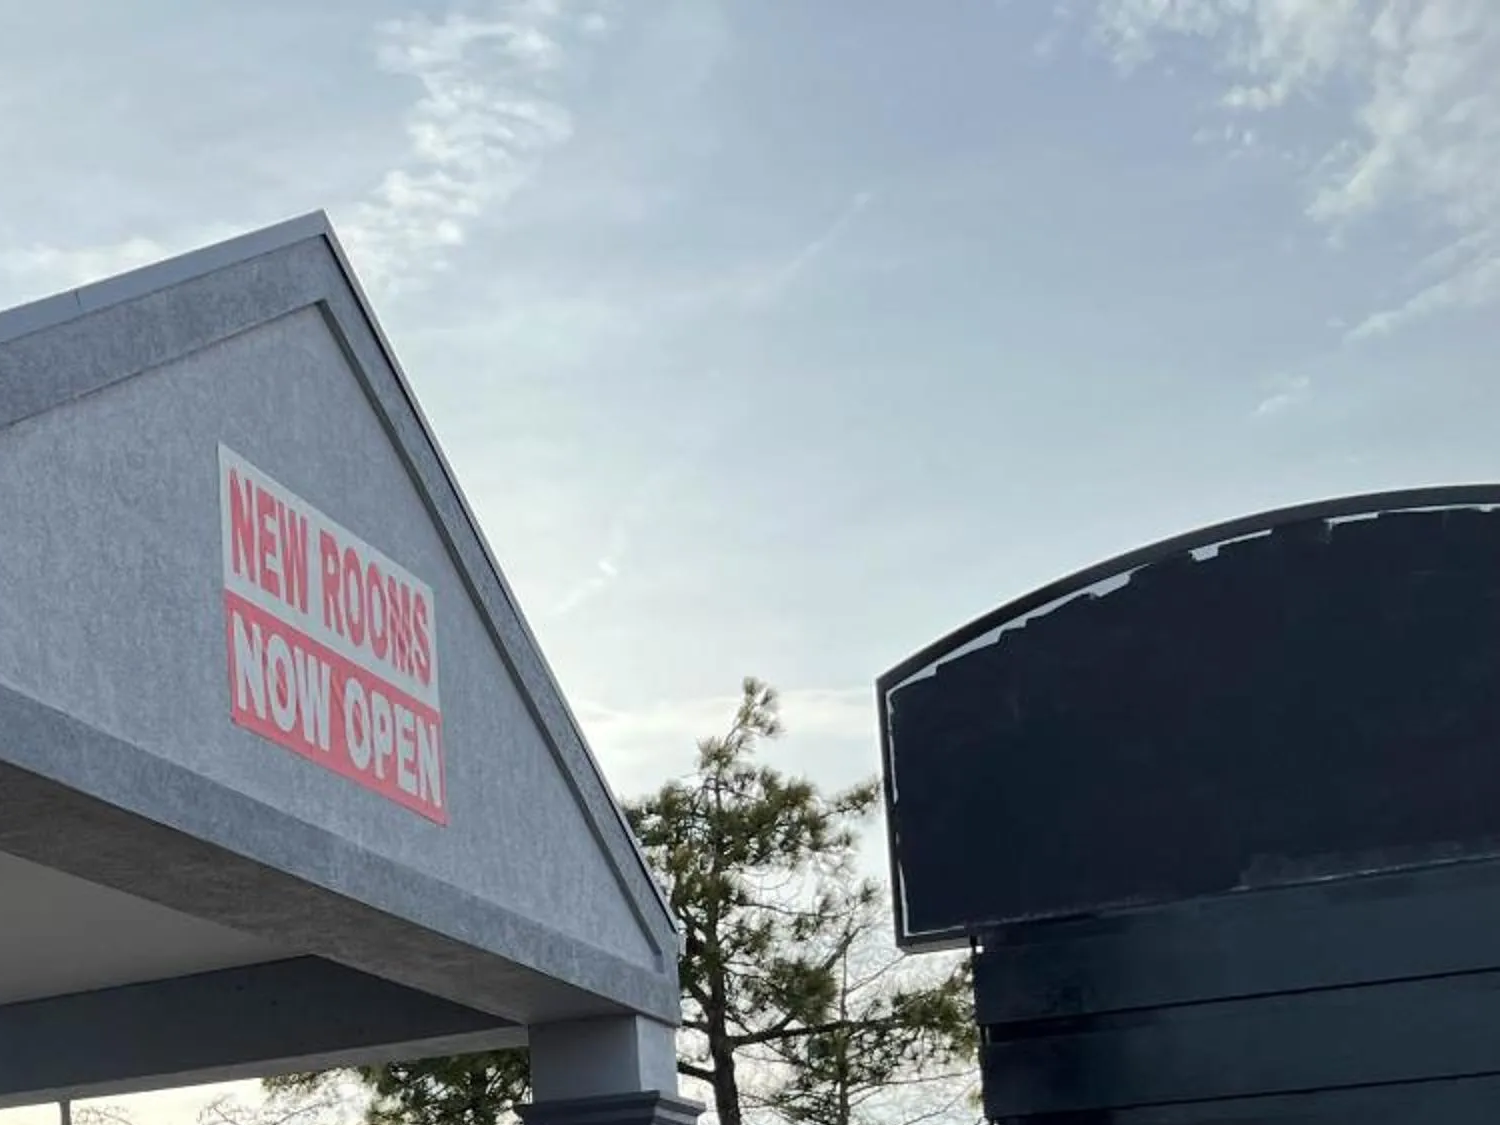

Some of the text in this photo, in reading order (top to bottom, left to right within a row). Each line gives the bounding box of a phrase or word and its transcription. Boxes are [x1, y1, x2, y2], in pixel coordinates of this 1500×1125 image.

[229, 467, 432, 690] NEW ROOMS
[232, 610, 443, 808] NOW OPEN
